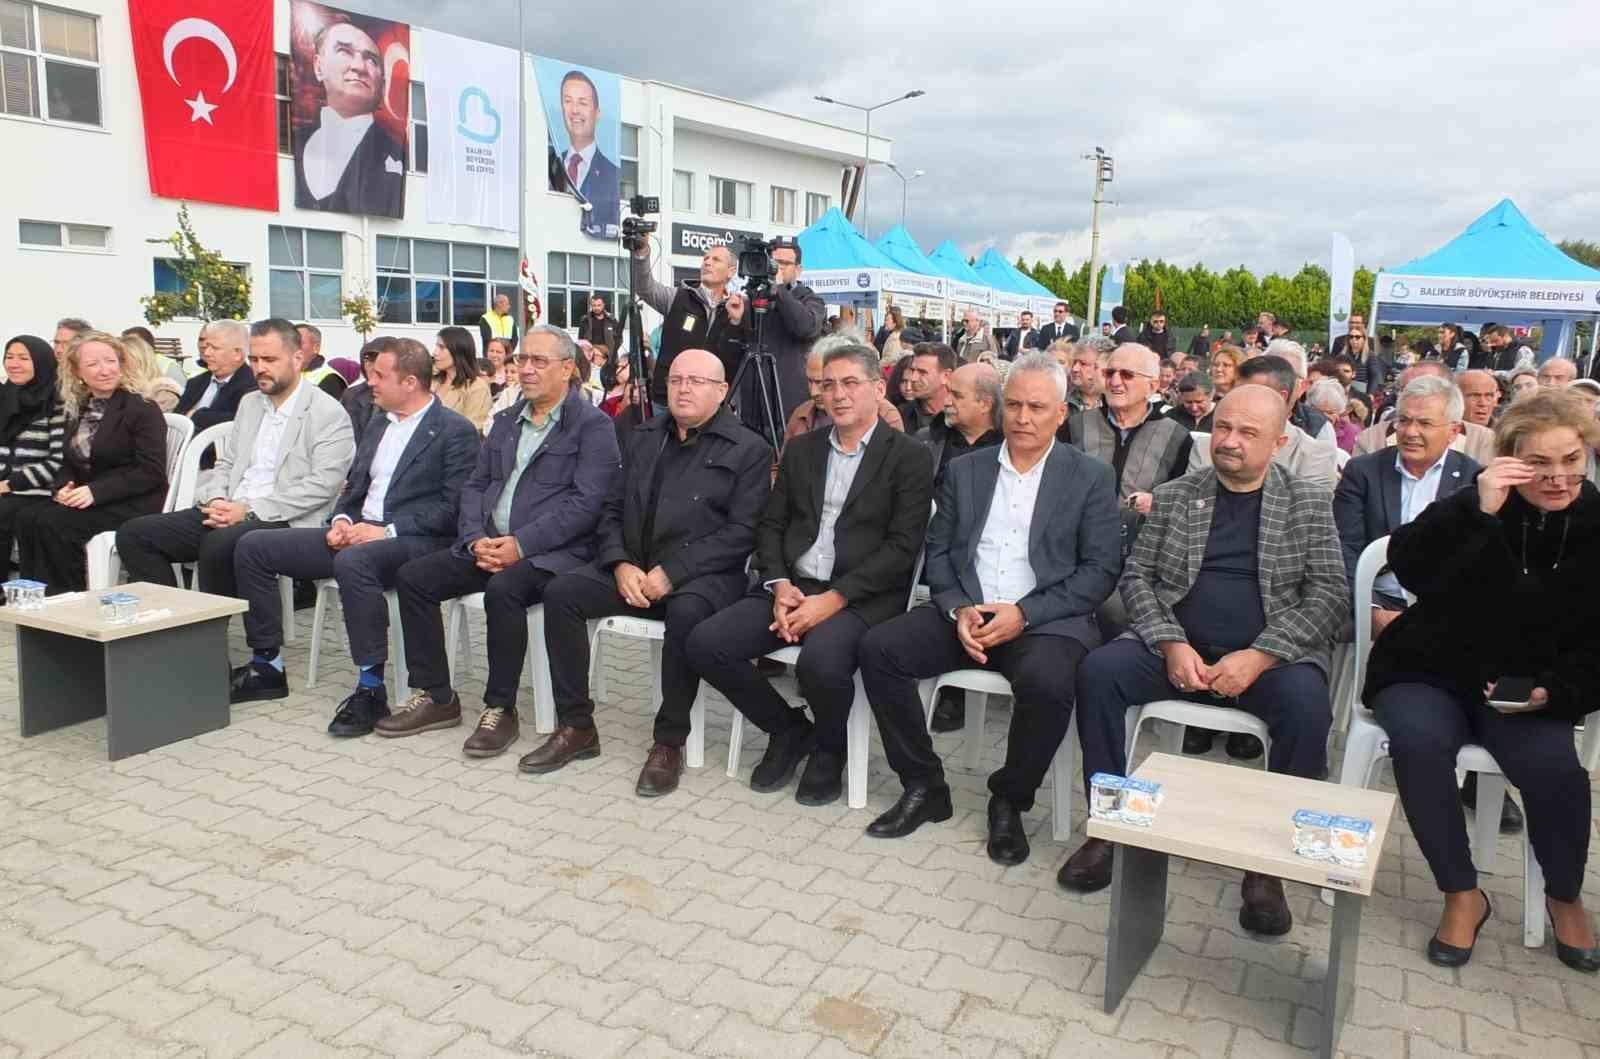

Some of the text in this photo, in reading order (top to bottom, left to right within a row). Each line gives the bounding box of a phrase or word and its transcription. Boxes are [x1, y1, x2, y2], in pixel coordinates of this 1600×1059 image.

[1420, 286, 1584, 302] BALIKESİR BÜYÜKŞEHİR BELEDİYESİ
